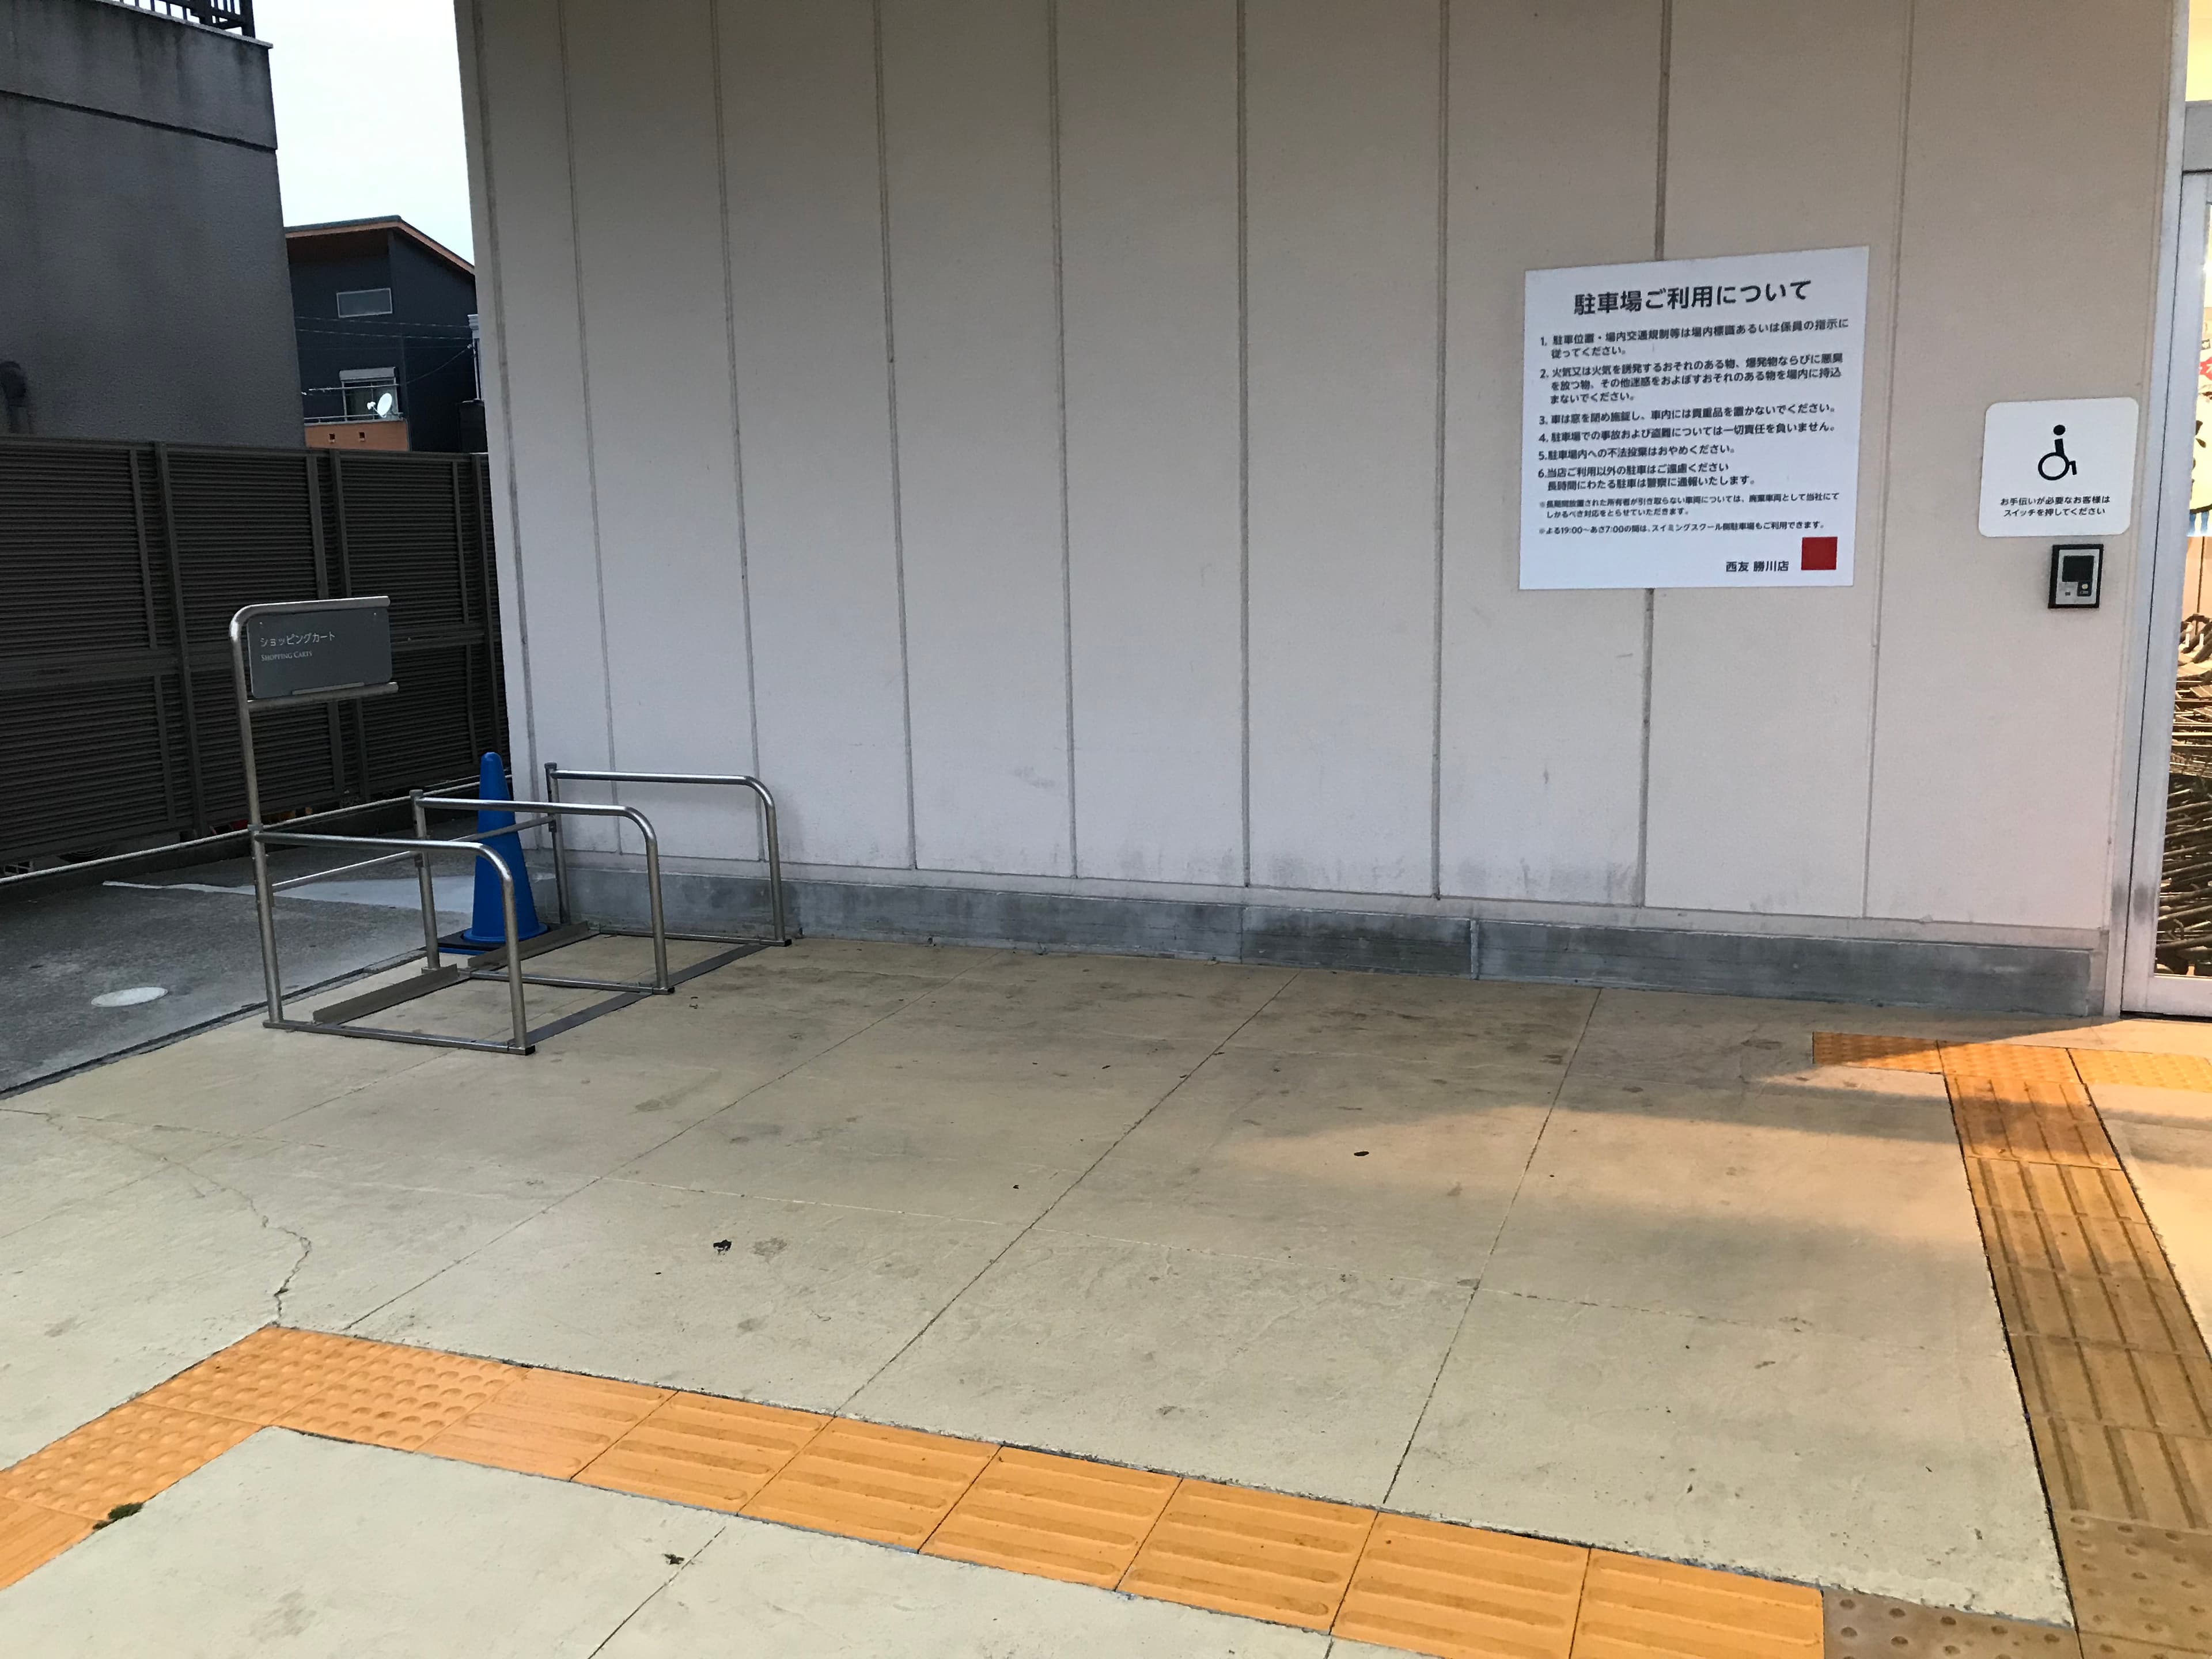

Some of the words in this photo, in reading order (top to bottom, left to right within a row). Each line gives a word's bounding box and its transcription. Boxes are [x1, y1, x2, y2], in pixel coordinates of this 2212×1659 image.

[1573, 279, 1811, 316] 駐車場ご利用について
[2001, 495, 2110, 506] お手伝いが必要なお客様は
[2003, 507, 2105, 517] スイッチを押してください
[1725, 560, 1749, 573] 西友
[1753, 560, 1789, 572] 勝川店
[260, 631, 335, 647] ショッピングカート
